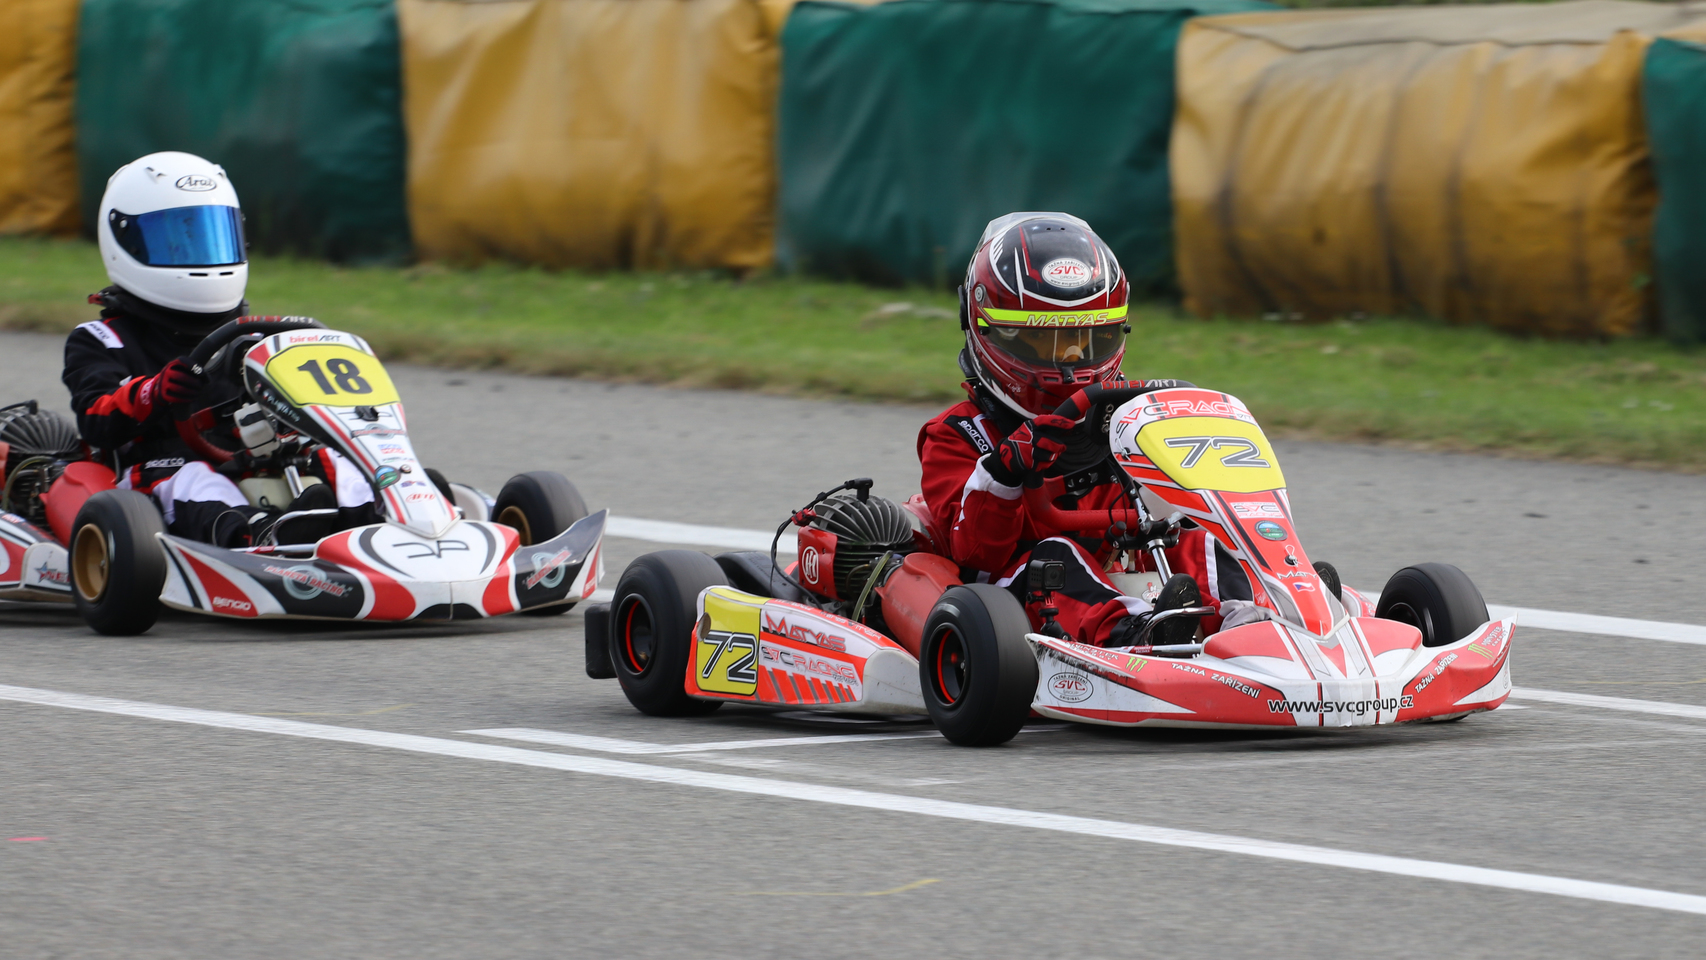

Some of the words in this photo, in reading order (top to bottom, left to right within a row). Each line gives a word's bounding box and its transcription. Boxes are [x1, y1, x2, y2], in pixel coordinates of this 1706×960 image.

[1050, 265, 1084, 276] SVC
[1026, 312, 1109, 327] MATYAS
[297, 358, 373, 395] 18
[957, 420, 989, 454] sparco
[1164, 436, 1271, 468] 72
[765, 611, 846, 653] MATYAS
[703, 630, 758, 684] 72
[1055, 680, 1086, 691] SVC
[1210, 673, 1261, 699] ZAŘÍZENÍ
[1267, 695, 1414, 716] www.svcgroup.cz
